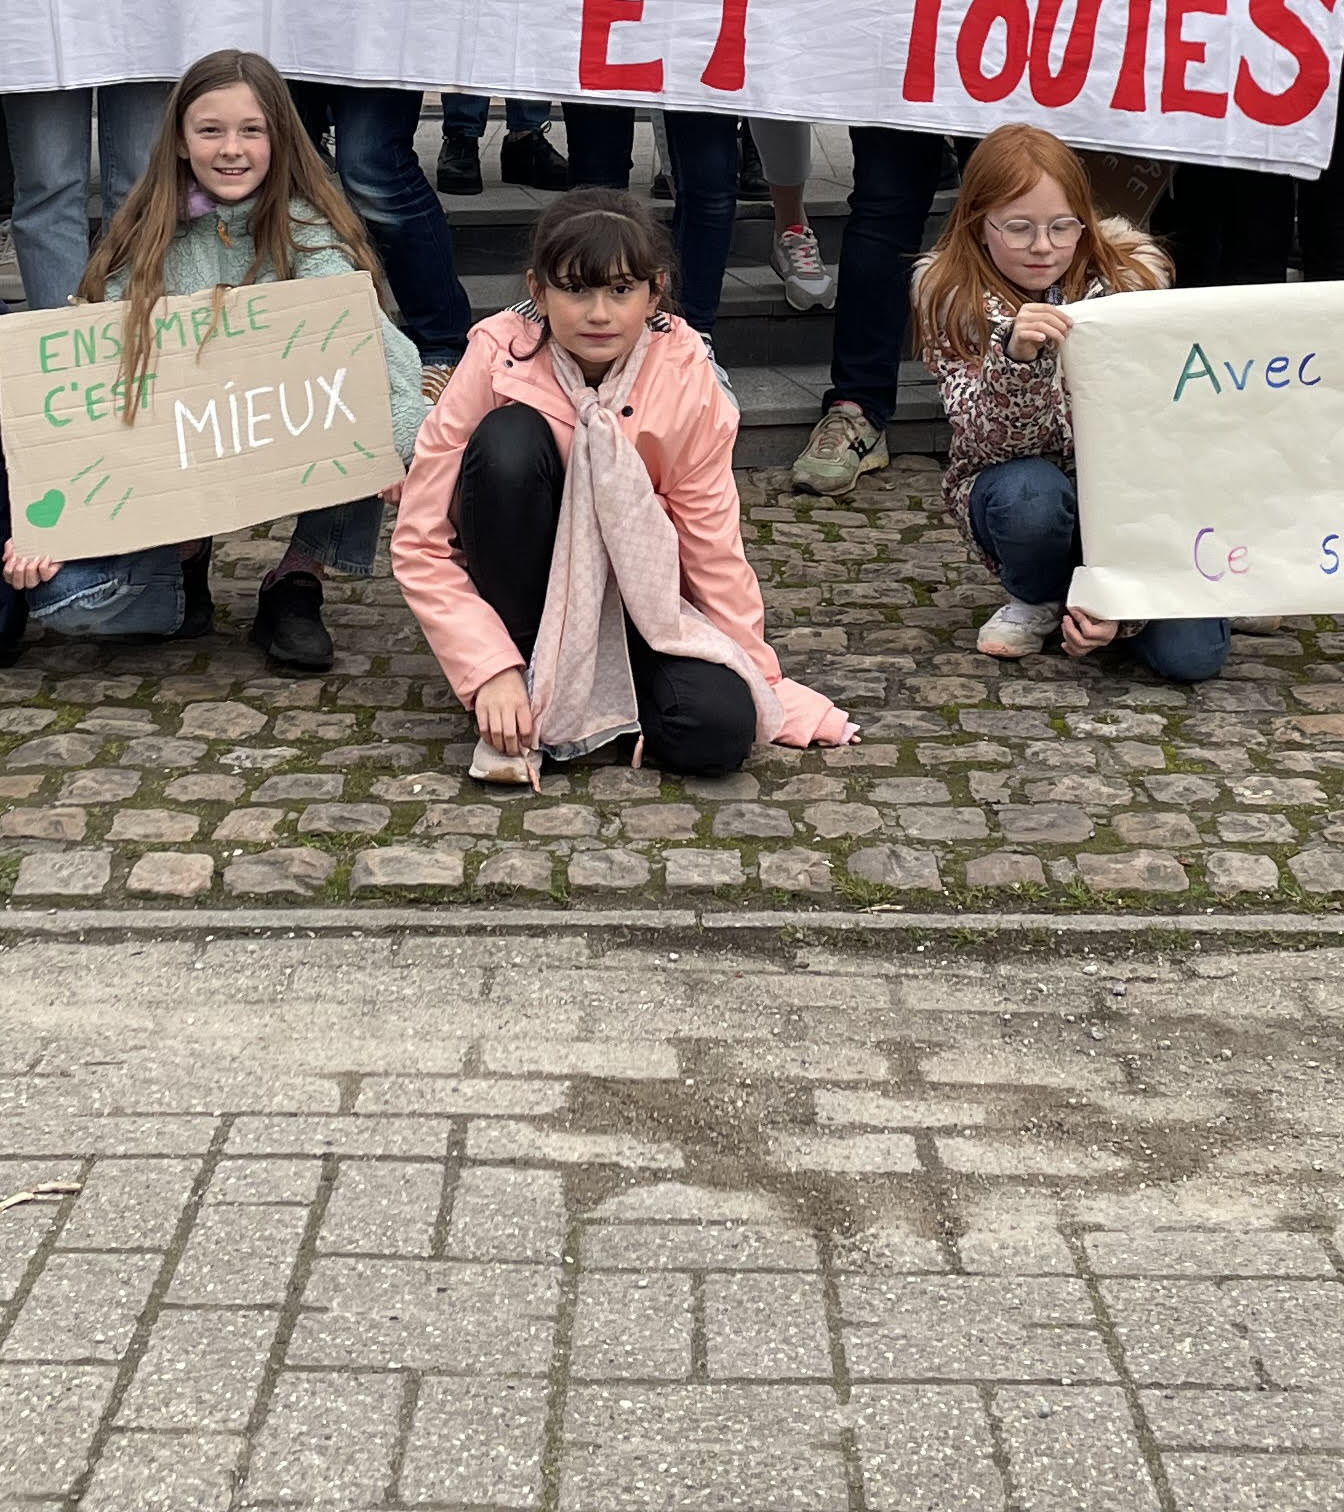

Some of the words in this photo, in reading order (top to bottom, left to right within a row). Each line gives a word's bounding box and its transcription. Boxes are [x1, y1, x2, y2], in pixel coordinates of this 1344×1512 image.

[39, 295, 272, 374] ENSMBLE
[1172, 342, 1324, 403] Avec
[1193, 526, 1252, 583] Ce
